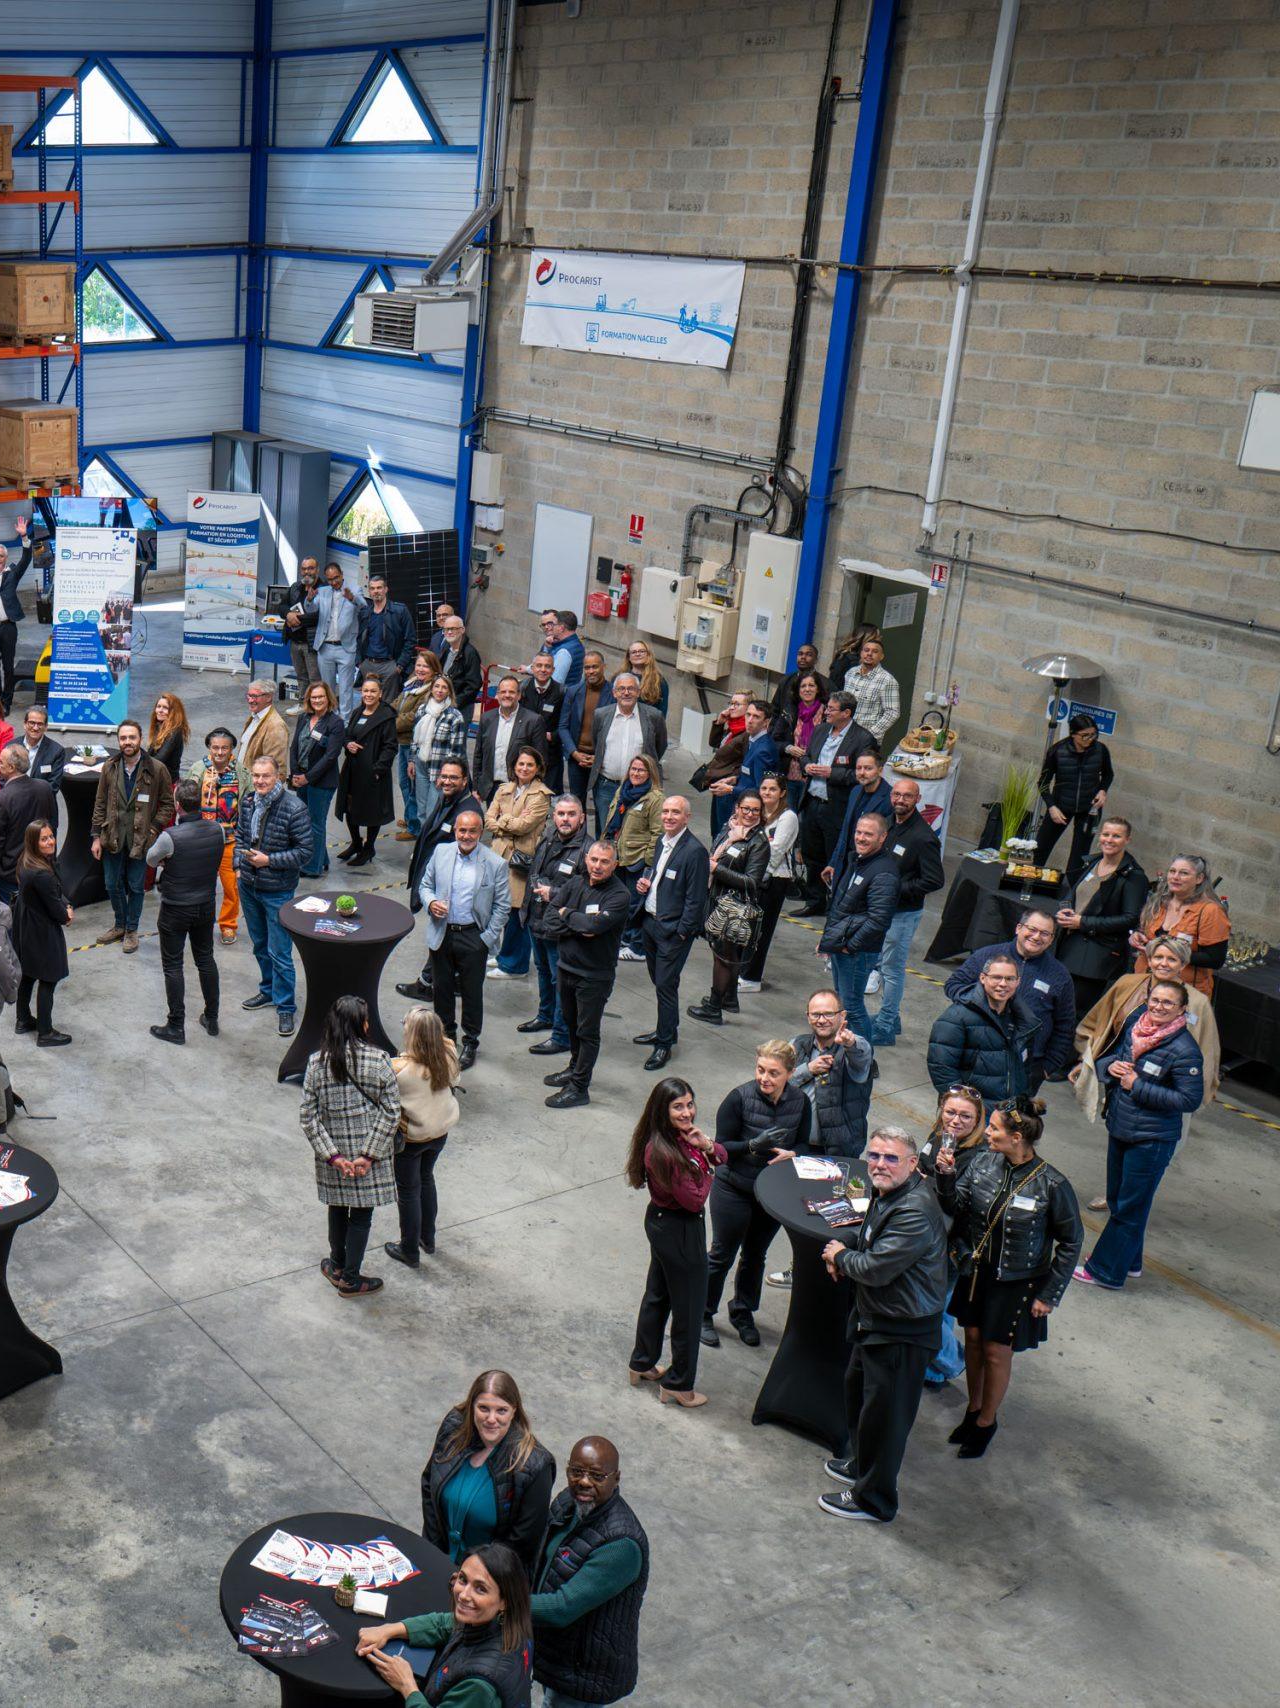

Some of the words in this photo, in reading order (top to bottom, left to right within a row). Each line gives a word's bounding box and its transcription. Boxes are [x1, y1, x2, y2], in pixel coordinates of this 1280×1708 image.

[558, 273, 603, 286] PROCARIST
[601, 330, 637, 341] FORMATION
[637, 334, 668, 345] NACELLES
